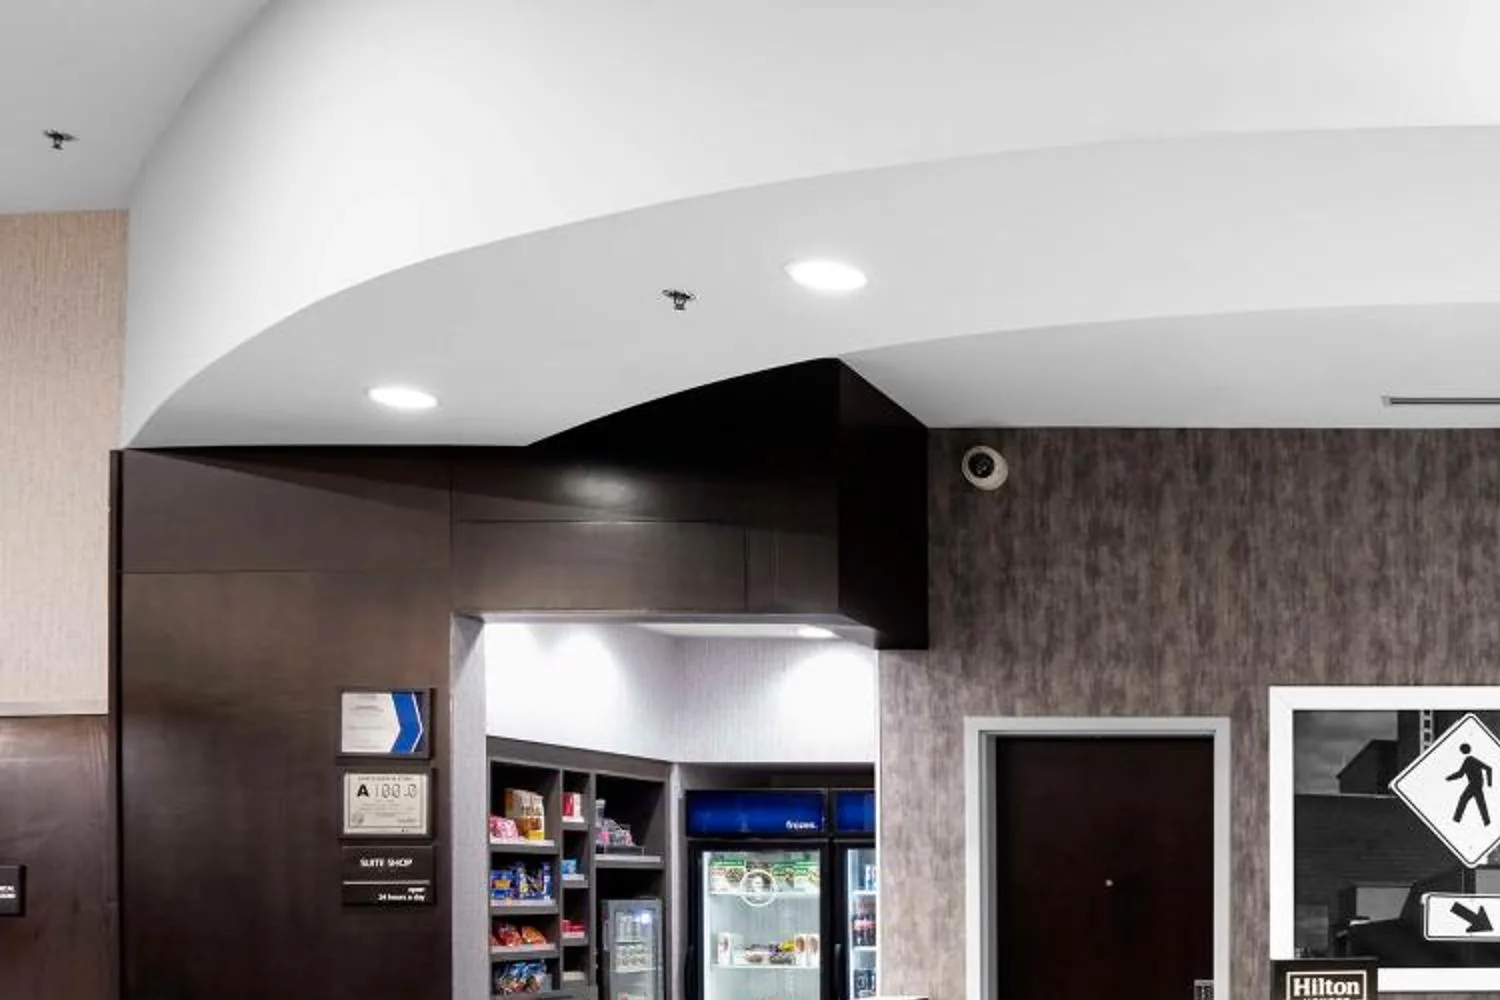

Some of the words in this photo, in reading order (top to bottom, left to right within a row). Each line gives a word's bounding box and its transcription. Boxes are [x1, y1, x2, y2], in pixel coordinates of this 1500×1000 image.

[357, 784, 369, 797] A
[360, 858, 385, 867] SUITE
[387, 858, 413, 867] SHOP
[1293, 977, 1360, 996] Hilton
